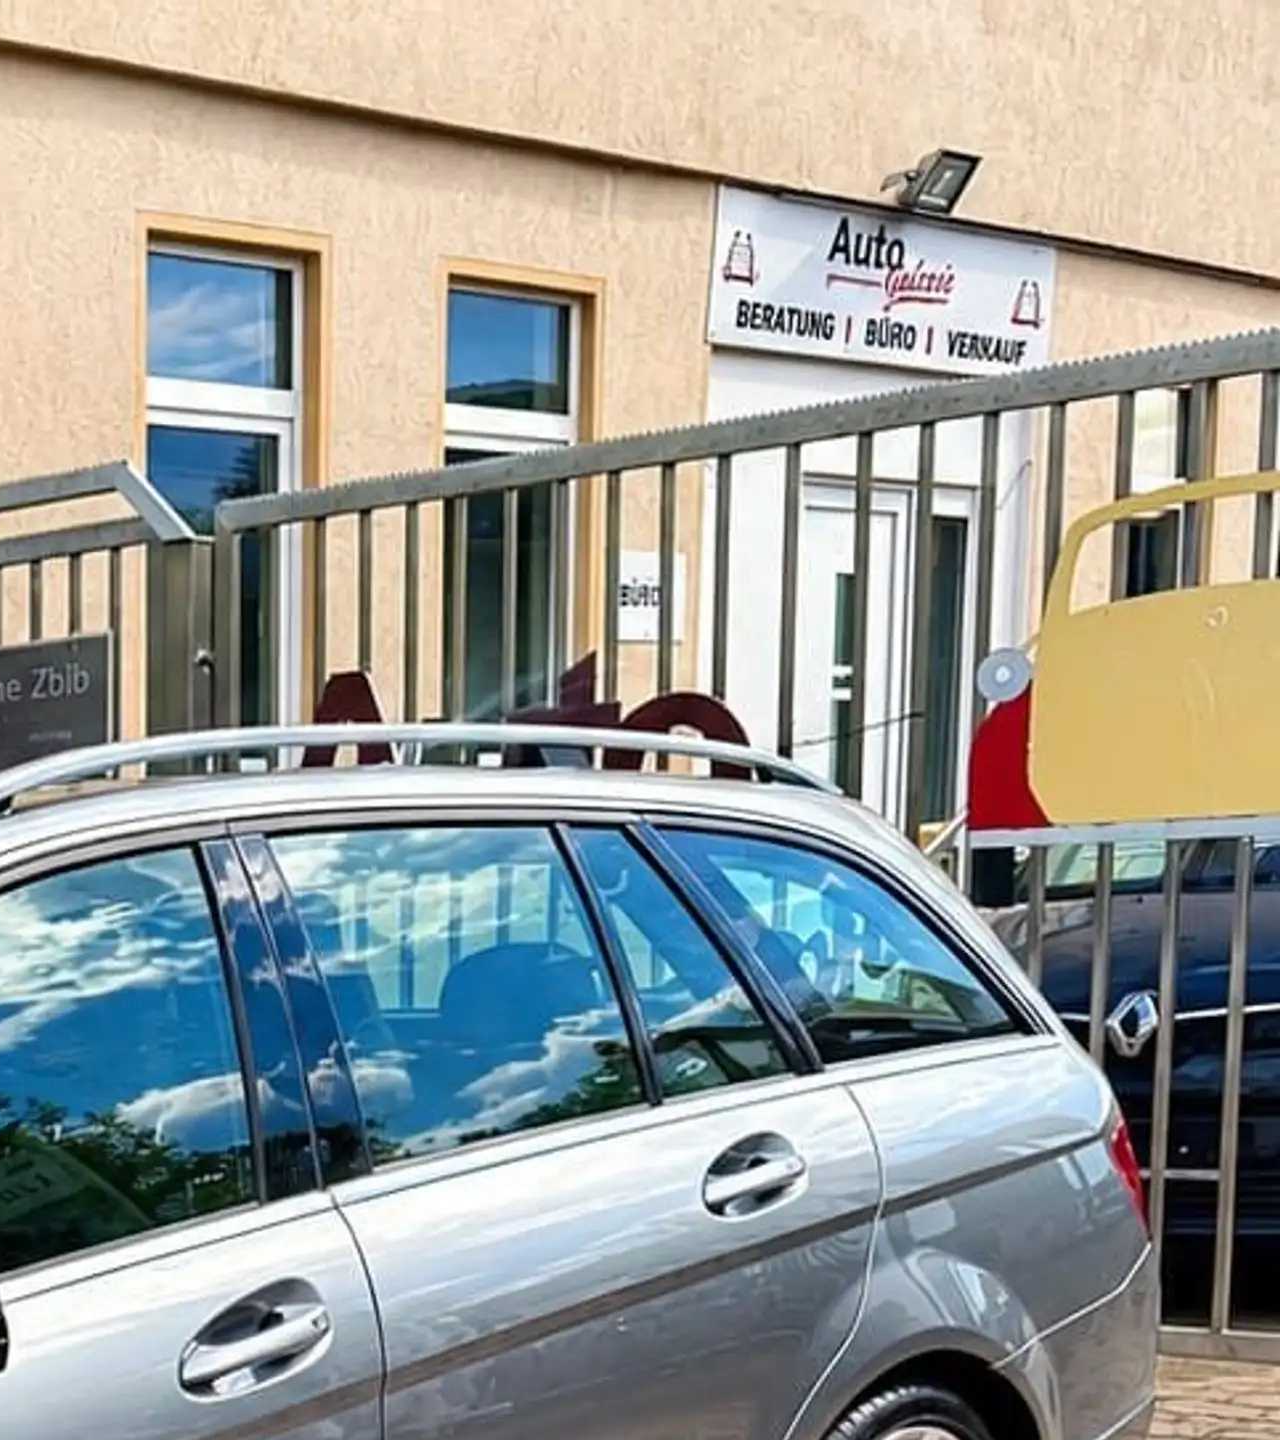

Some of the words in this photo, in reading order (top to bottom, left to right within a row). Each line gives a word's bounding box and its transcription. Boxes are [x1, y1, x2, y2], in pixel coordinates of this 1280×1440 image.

[827, 216, 906, 269] Auto
[735, 299, 835, 341] BERATUNG
[864, 316, 917, 351] BÜRO
[947, 330, 1027, 366] VERKAUF
